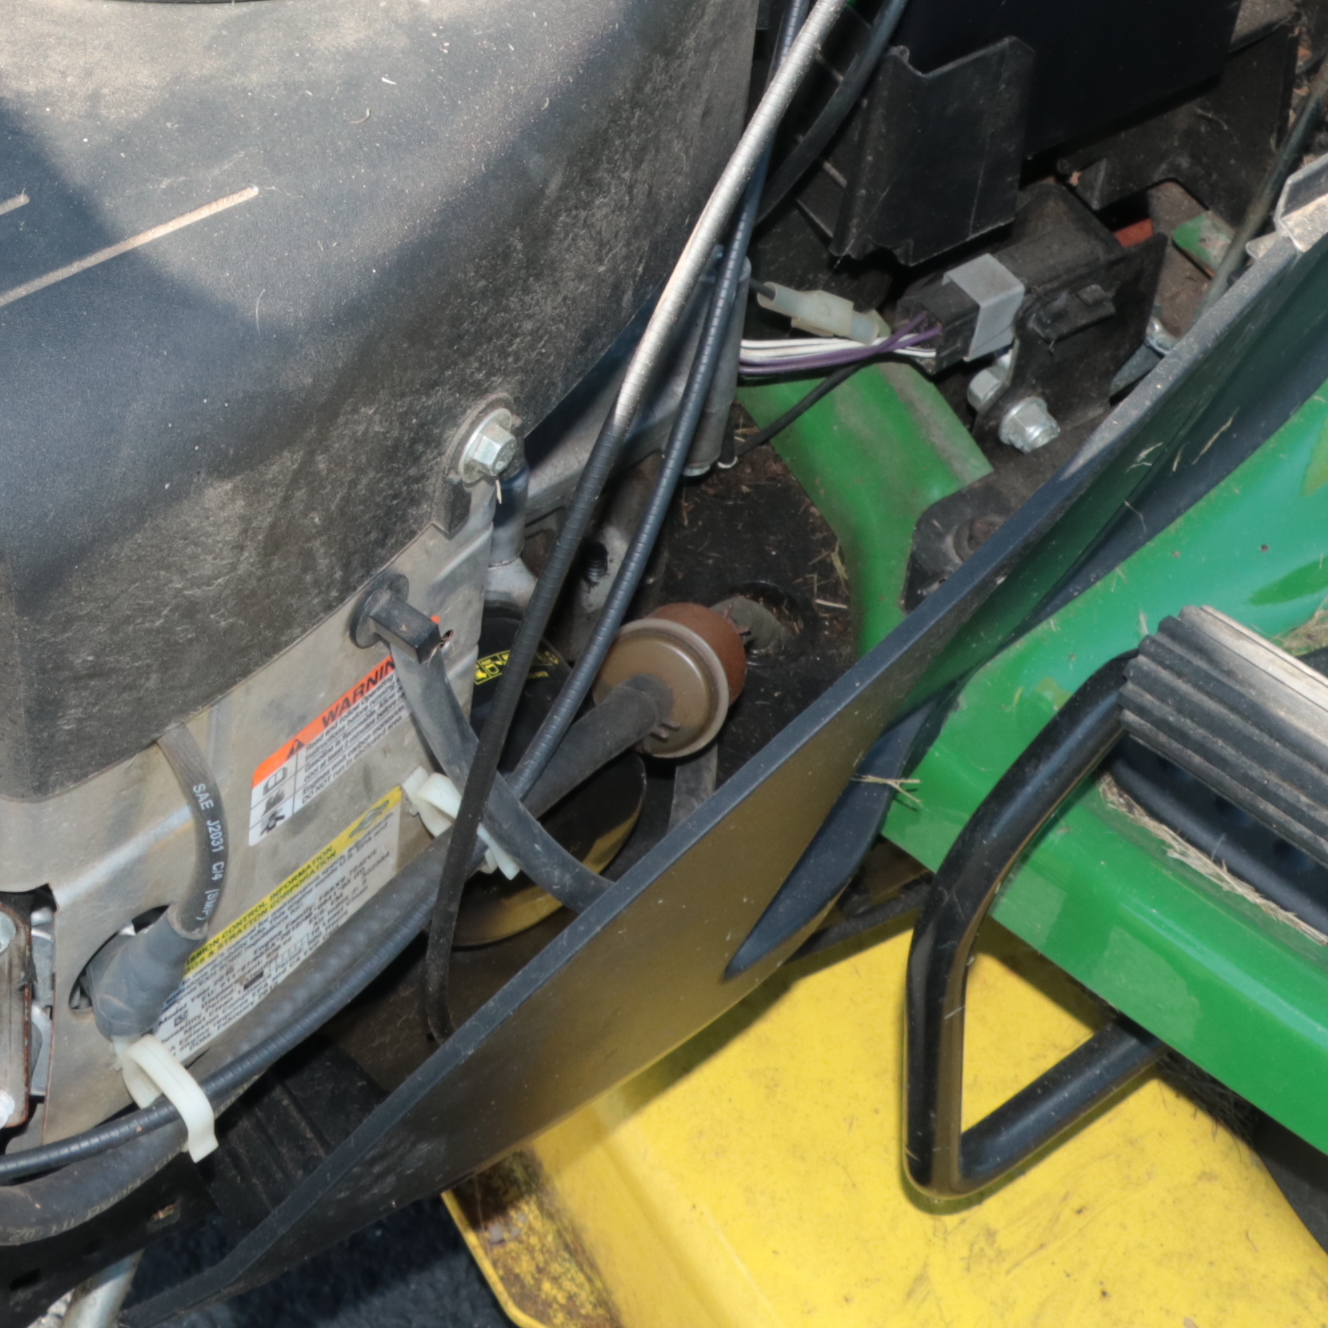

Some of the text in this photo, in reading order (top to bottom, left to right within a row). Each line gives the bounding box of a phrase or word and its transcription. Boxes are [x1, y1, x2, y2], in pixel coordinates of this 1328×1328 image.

[322, 656, 396, 728] WARNIN
[191, 782, 214, 811] SAE
[302, 790, 313, 805] DO
[315, 775, 331, 792] NOT
[205, 817, 224, 853] J2031
[211, 860, 221, 880] C/4
[222, 898, 266, 940] CONTROL
[269, 844, 332, 902] INFORMATION
